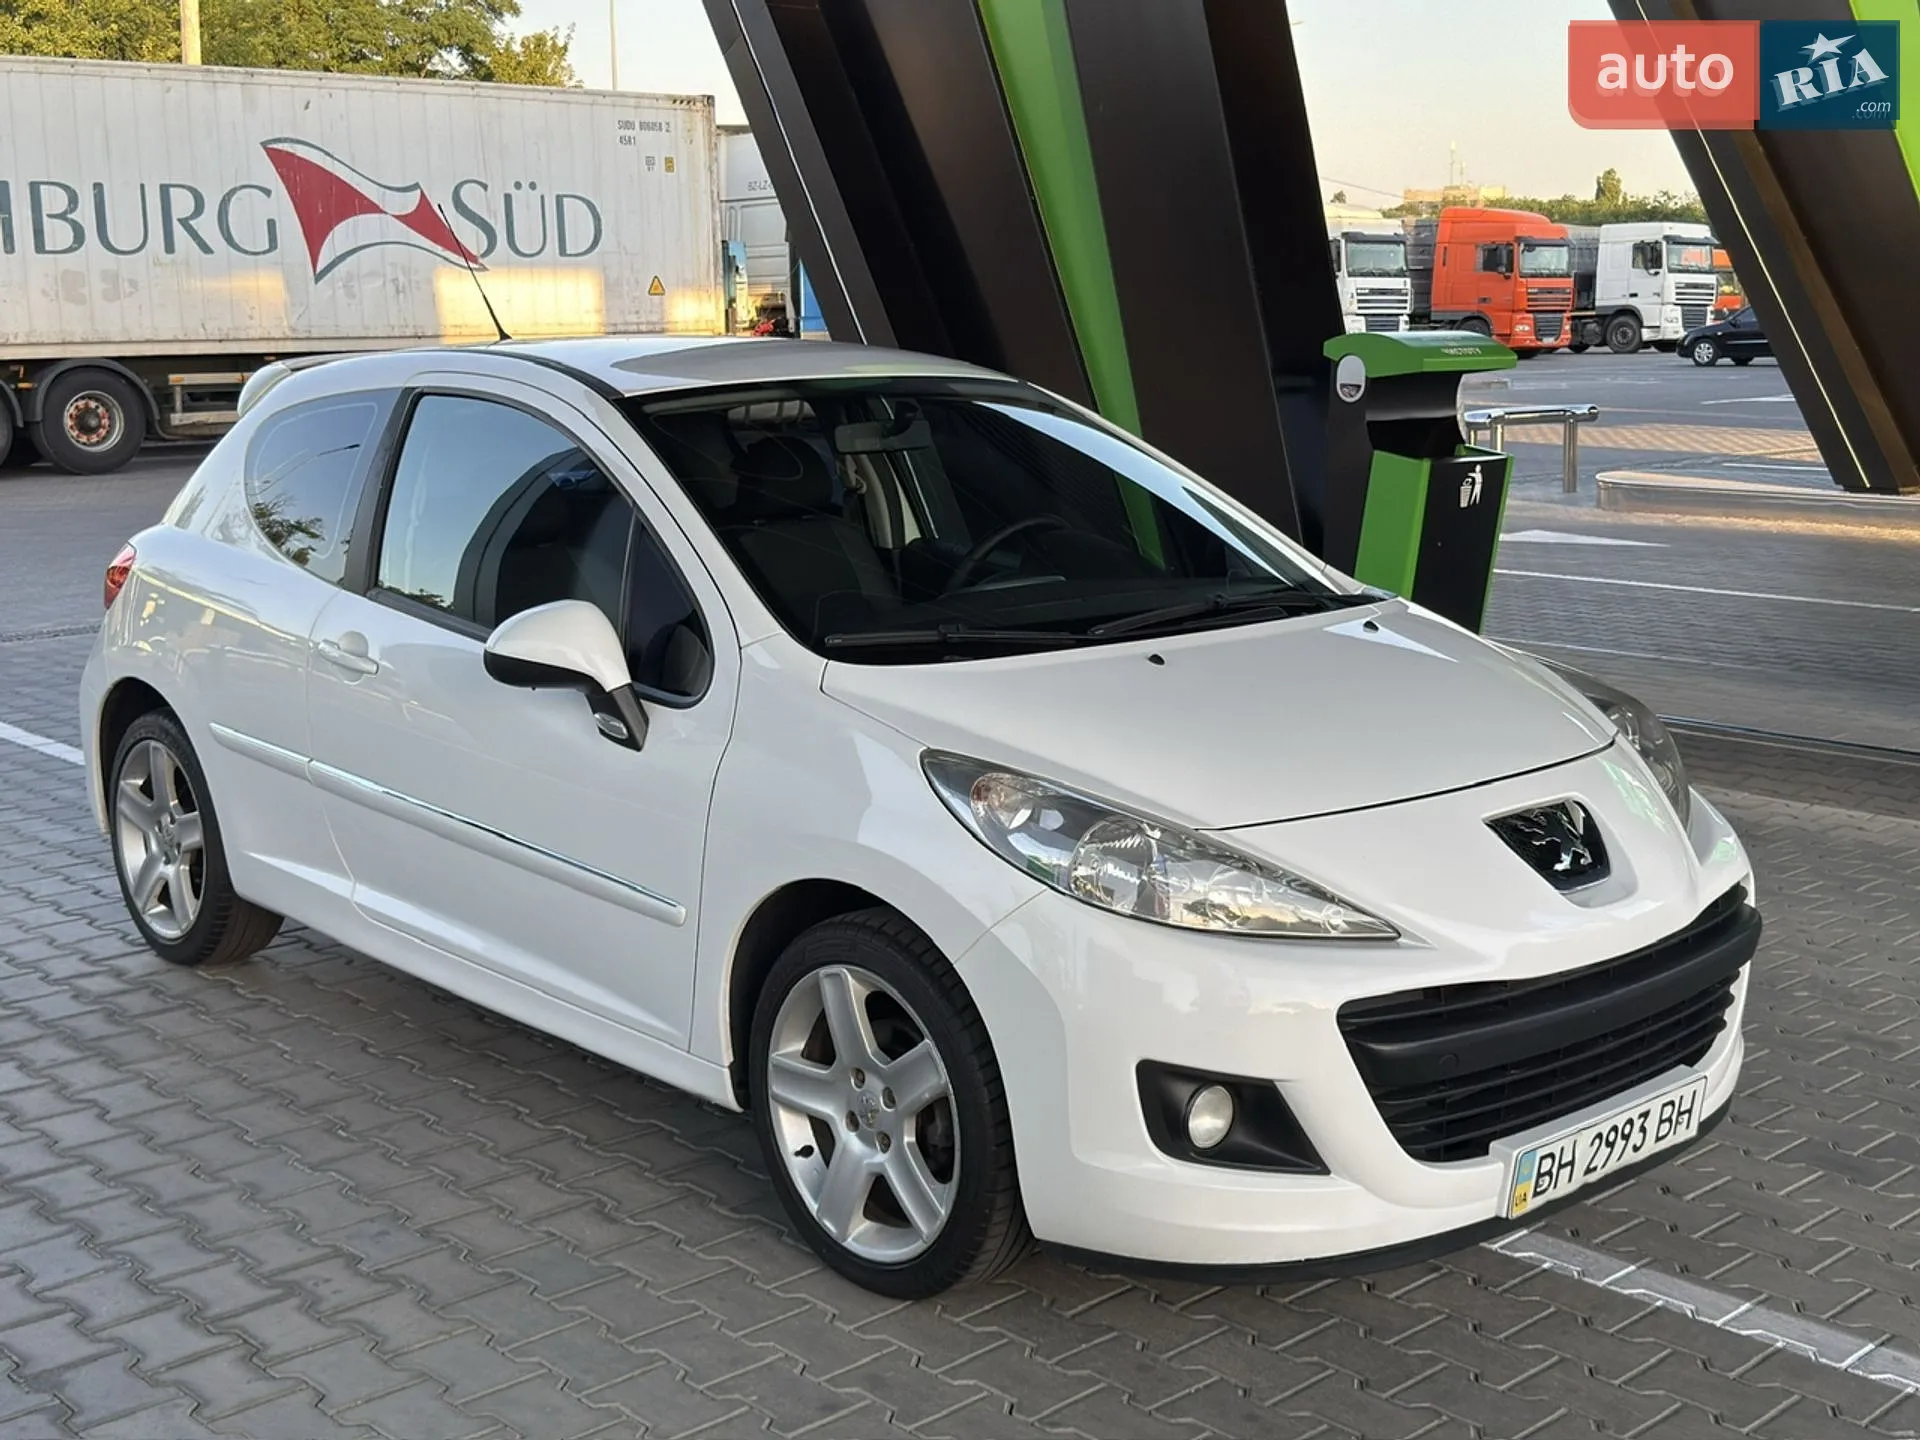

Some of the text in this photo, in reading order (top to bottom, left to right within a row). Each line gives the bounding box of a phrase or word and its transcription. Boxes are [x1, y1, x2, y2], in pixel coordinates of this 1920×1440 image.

[451, 178, 603, 258] SÜD
[1532, 1089, 1697, 1199] BH 2993 BH
